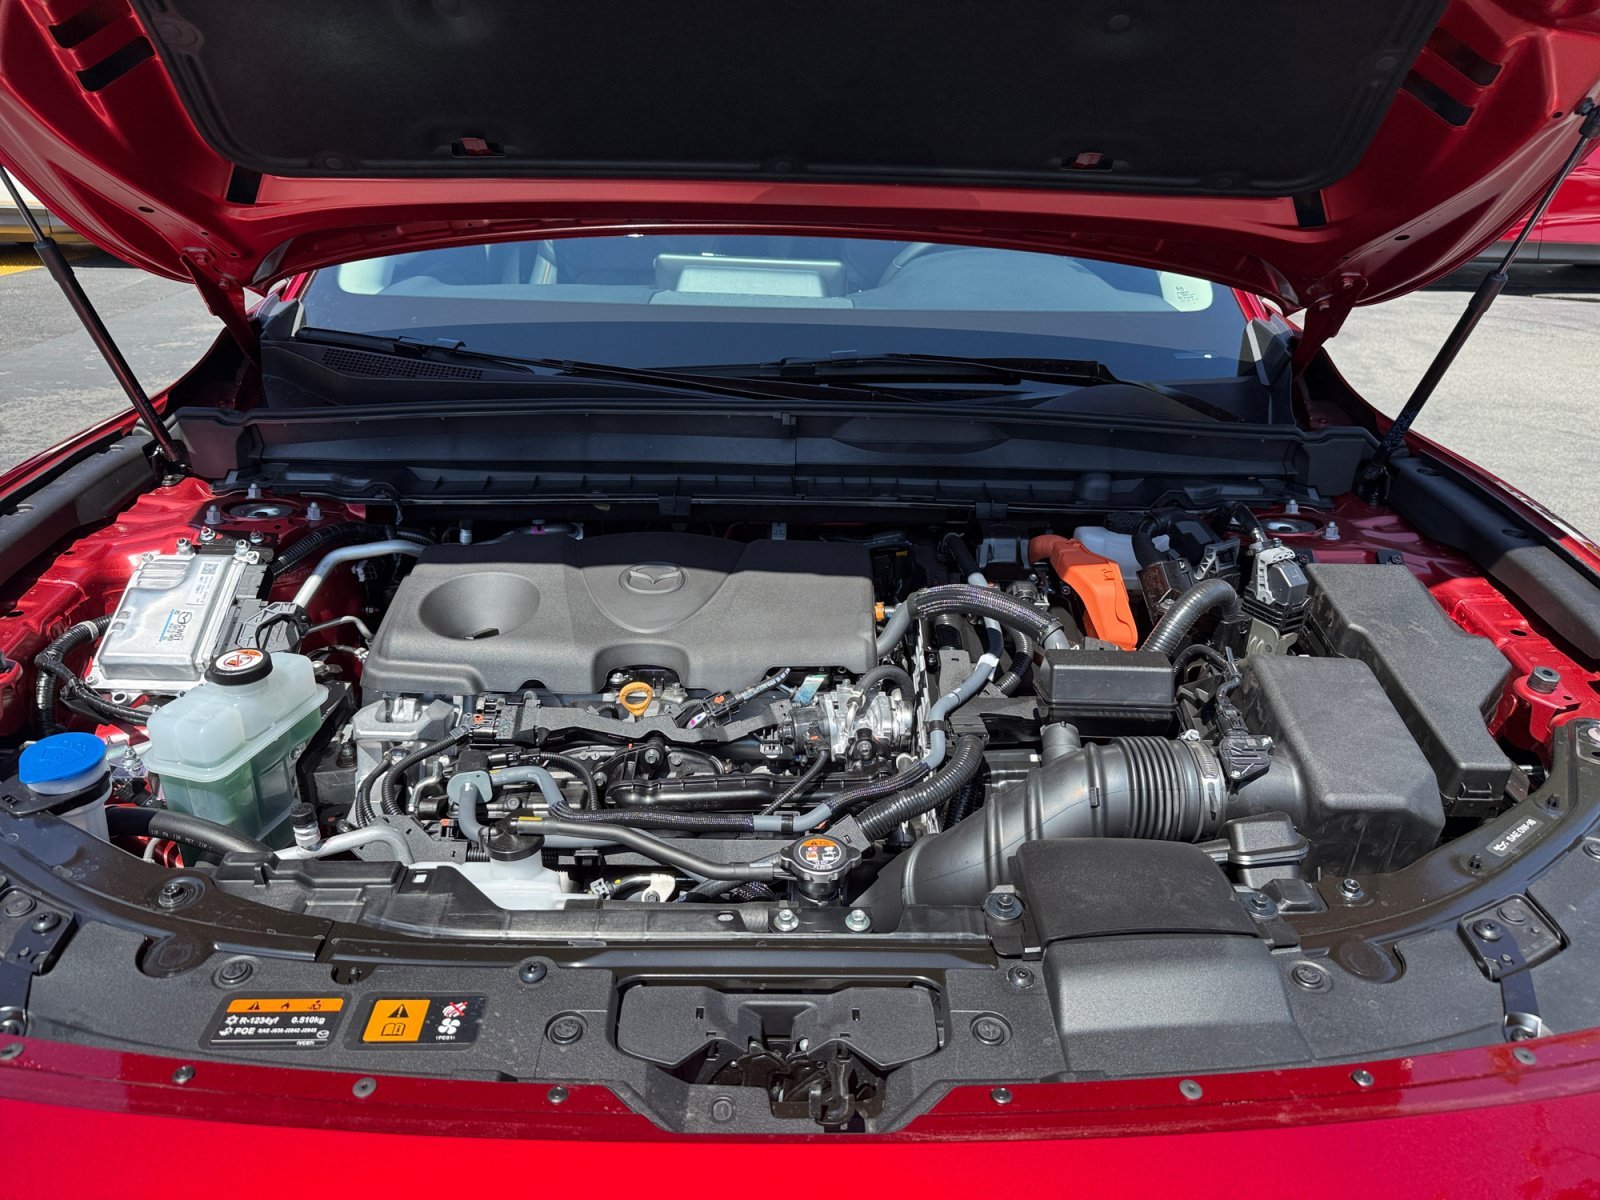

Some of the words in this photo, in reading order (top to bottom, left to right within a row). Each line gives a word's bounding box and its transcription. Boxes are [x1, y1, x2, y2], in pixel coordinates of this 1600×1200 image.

[1506, 830, 1522, 842] SAE
[239, 1016, 280, 1025] R-1234yf
[290, 1016, 326, 1025] 0.510kg
[233, 1027, 257, 1036] POE
